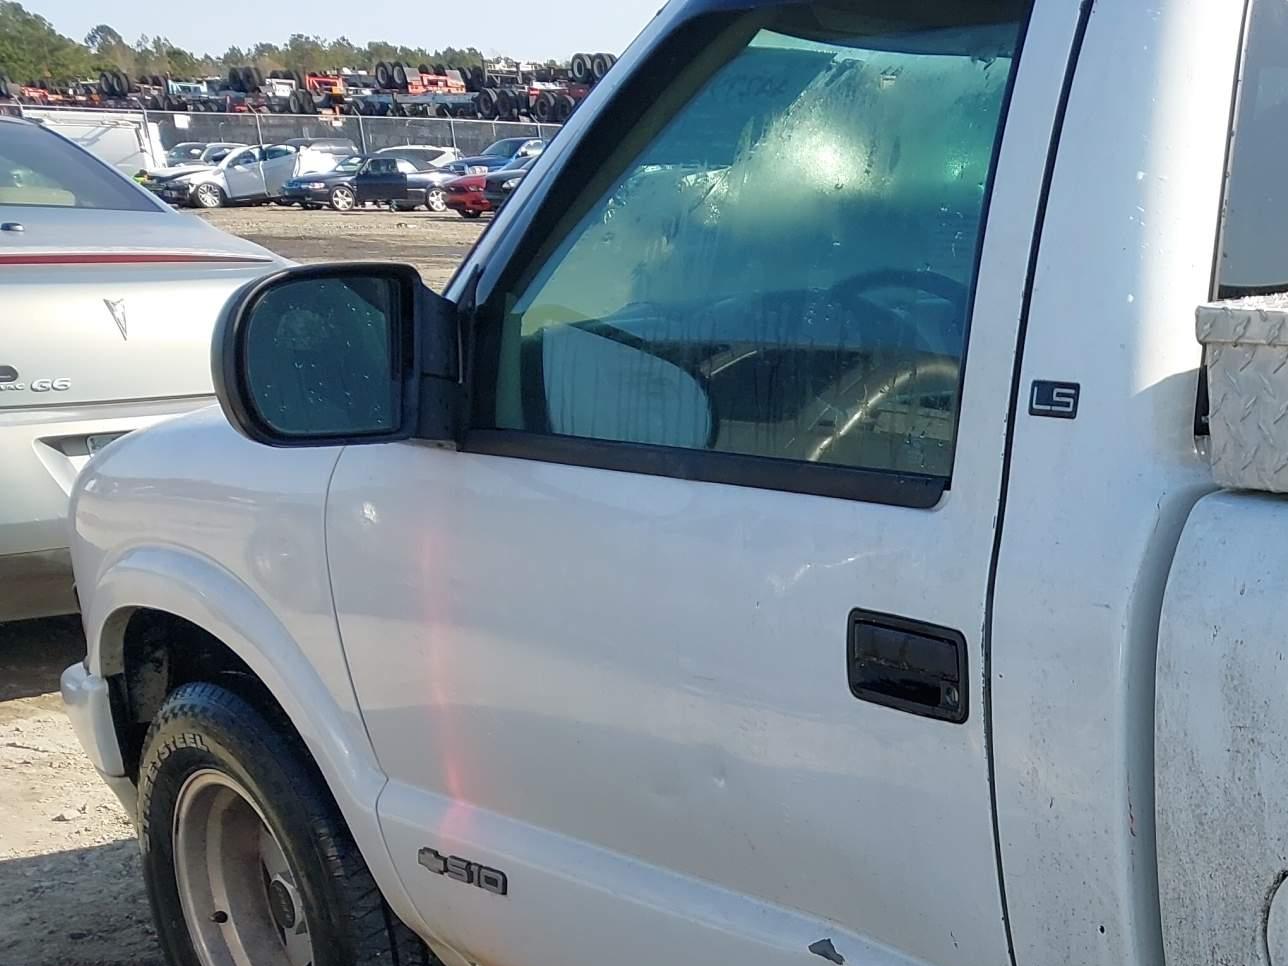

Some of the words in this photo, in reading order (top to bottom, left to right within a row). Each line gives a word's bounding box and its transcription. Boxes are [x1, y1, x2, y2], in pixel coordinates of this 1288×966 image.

[31, 378, 71, 392] G6
[1032, 386, 1076, 412] LS
[446, 855, 508, 895] S10
